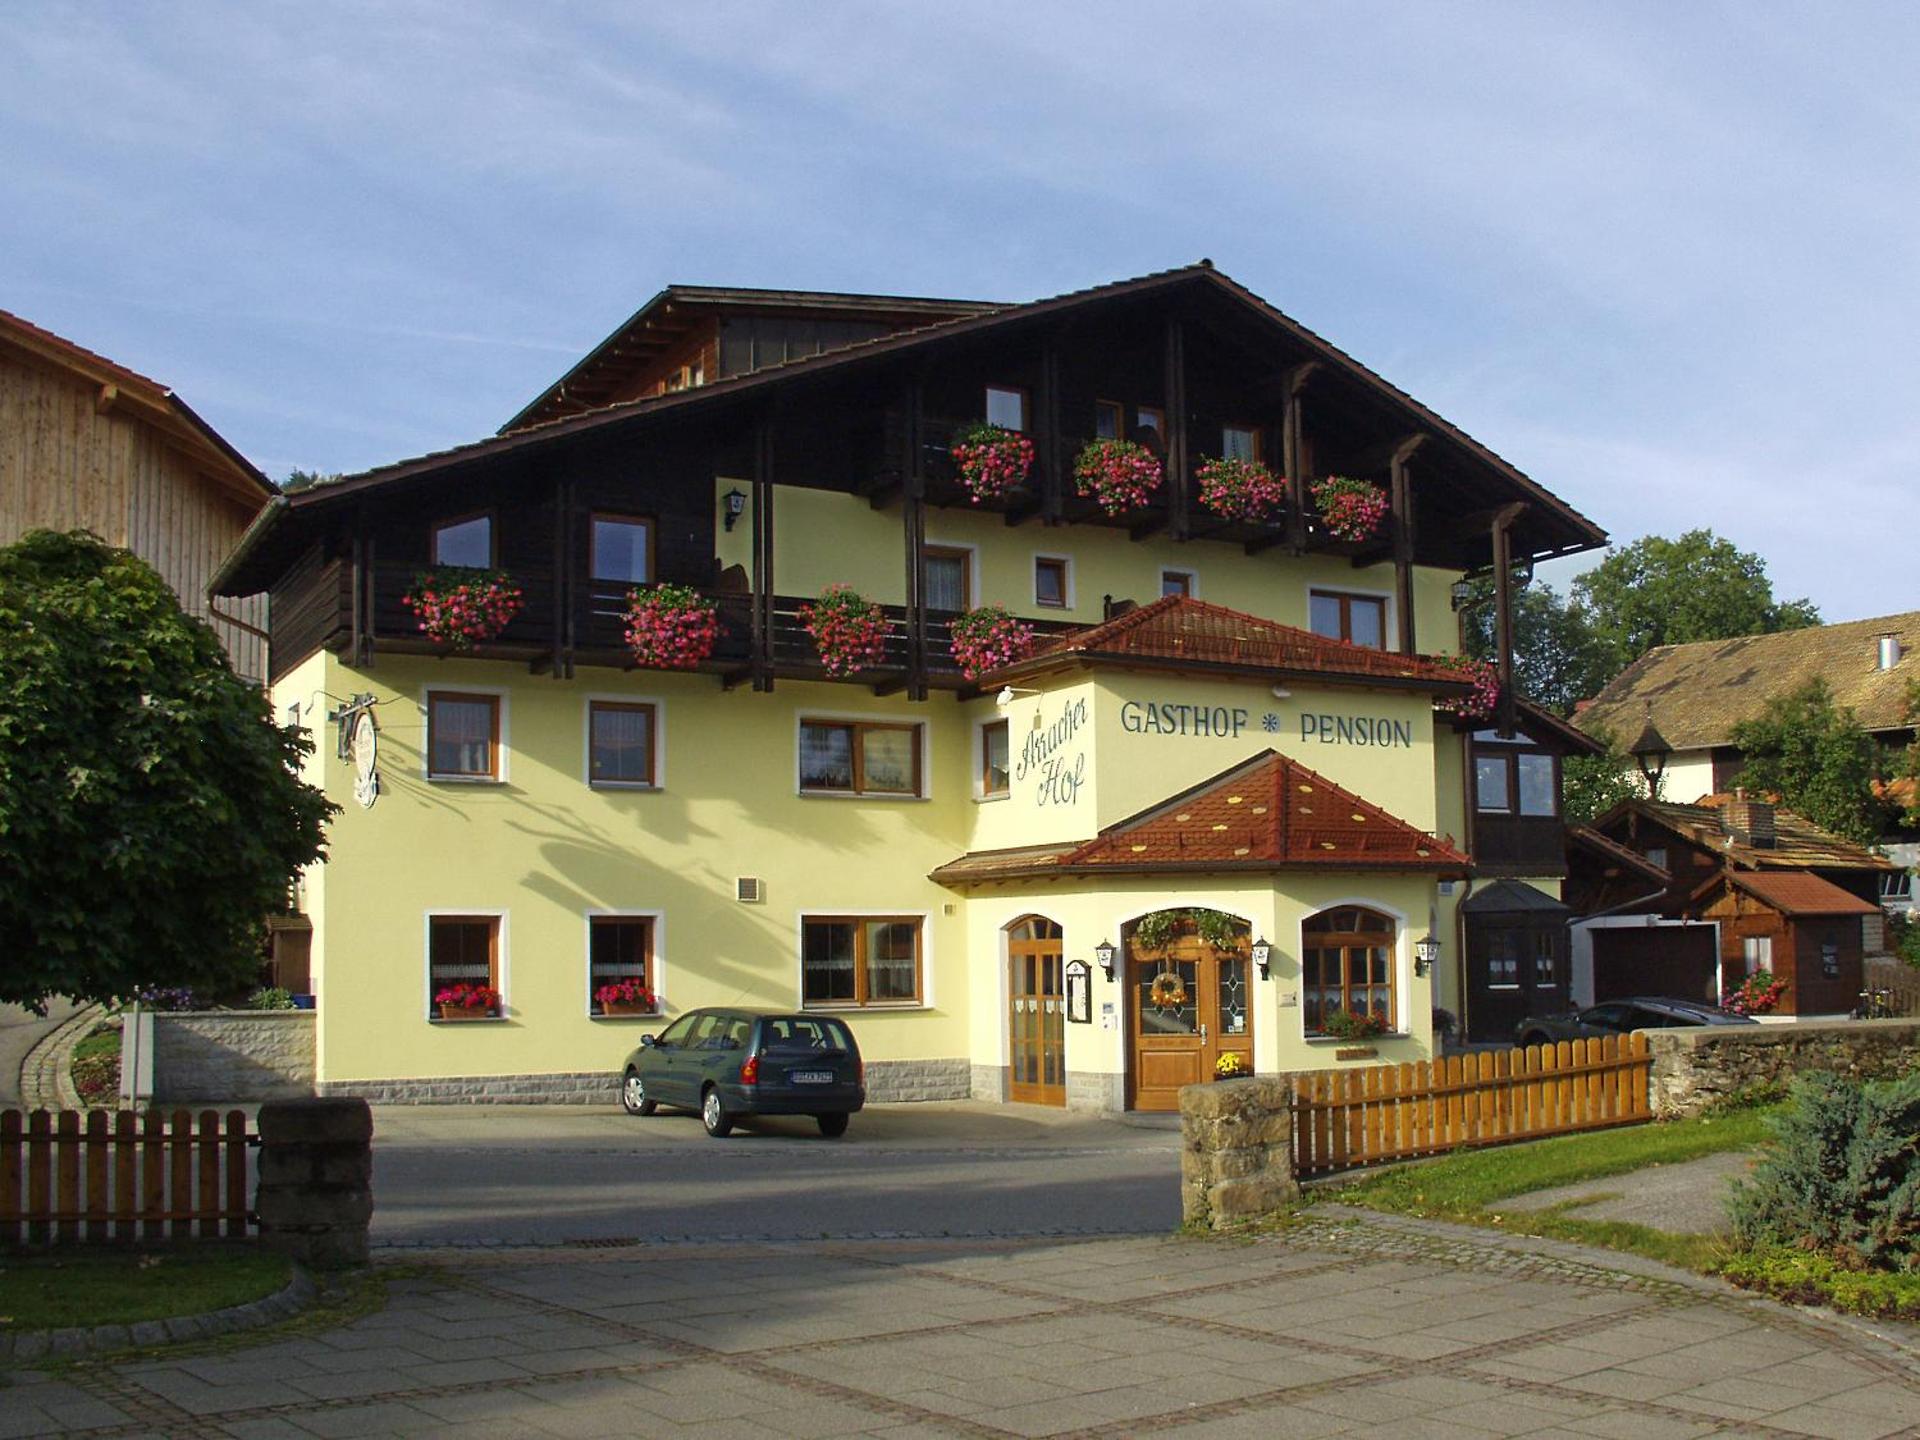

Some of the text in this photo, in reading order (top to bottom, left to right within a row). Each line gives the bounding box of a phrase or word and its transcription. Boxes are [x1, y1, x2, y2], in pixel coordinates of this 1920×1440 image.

[1016, 697, 1088, 781] Arracher
[1120, 700, 1412, 748] GASTHOF PENSION
[1037, 752, 1085, 807] Hof
